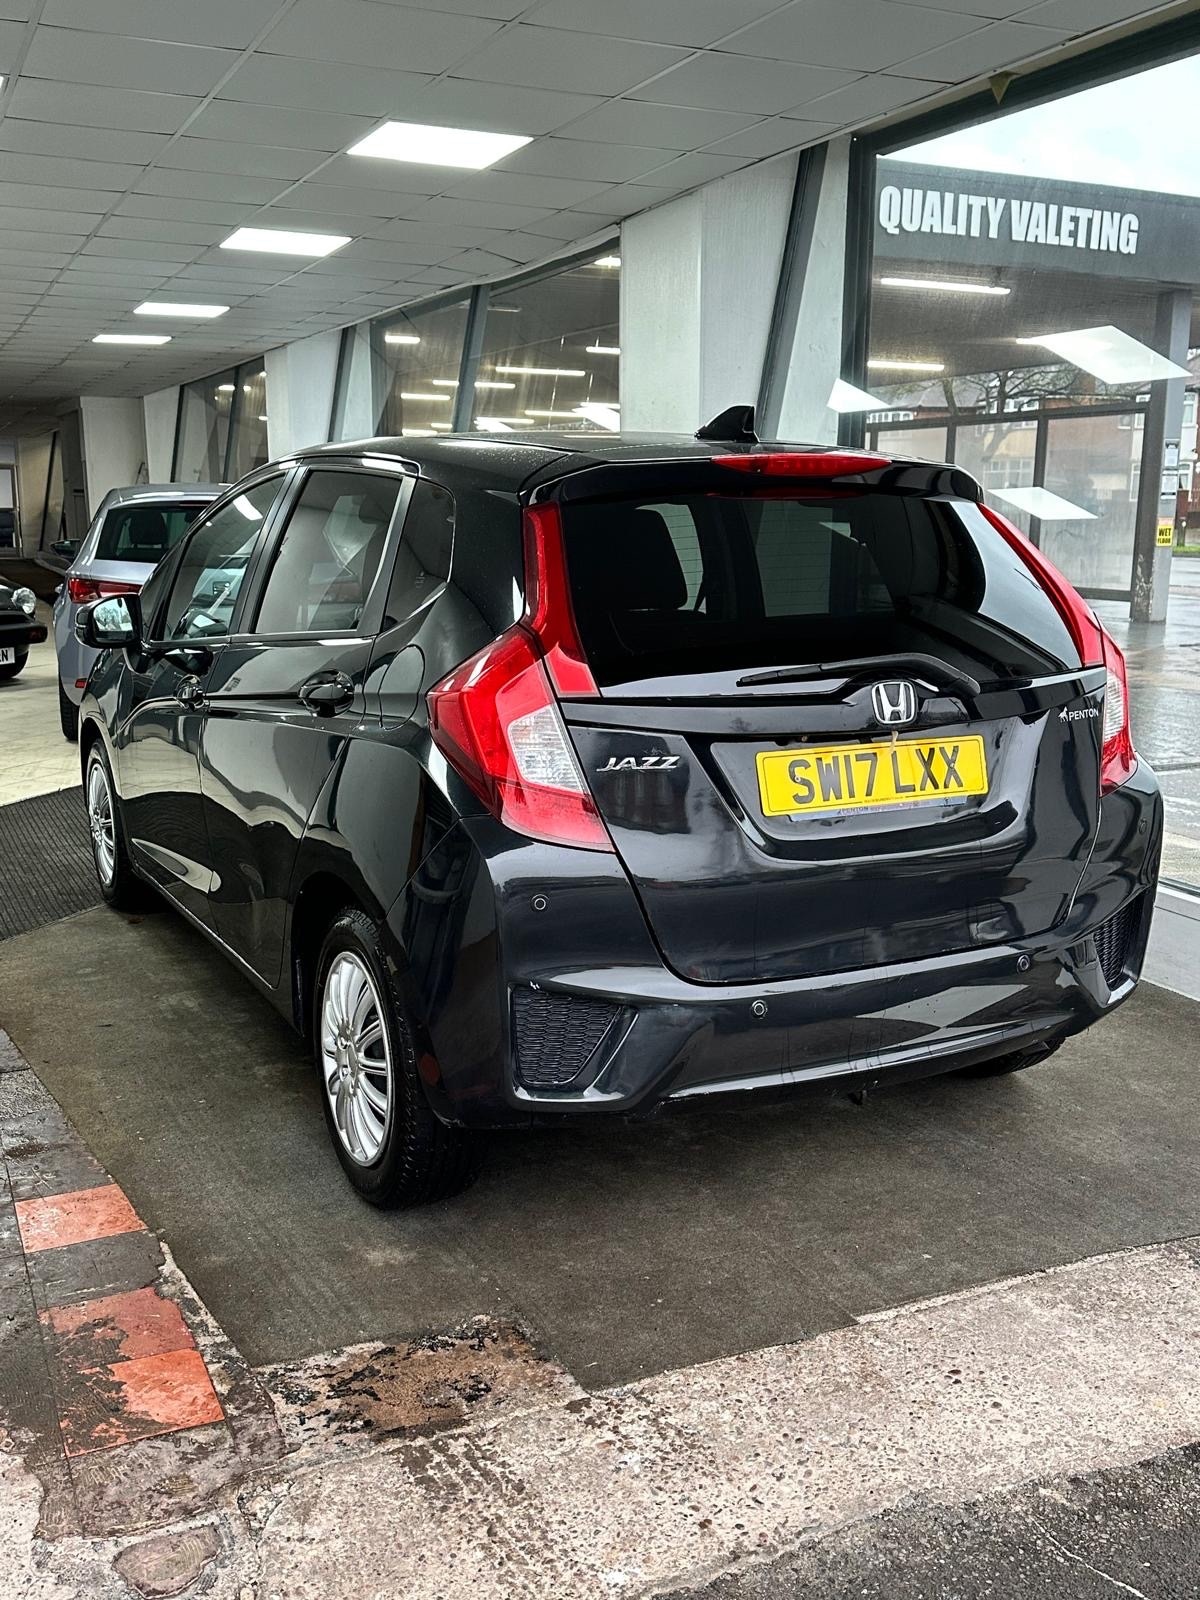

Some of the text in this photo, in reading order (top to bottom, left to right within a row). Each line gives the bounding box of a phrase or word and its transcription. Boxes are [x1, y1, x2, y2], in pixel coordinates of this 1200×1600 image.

[879, 185, 1139, 254] QUALITY VALETING
[1159, 528, 1171, 536] WET
[0, 649, 8, 661] N
[1068, 708, 1099, 721] PENTON
[596, 755, 680, 772] JAZZ
[788, 745, 964, 805] SW17 LXX
